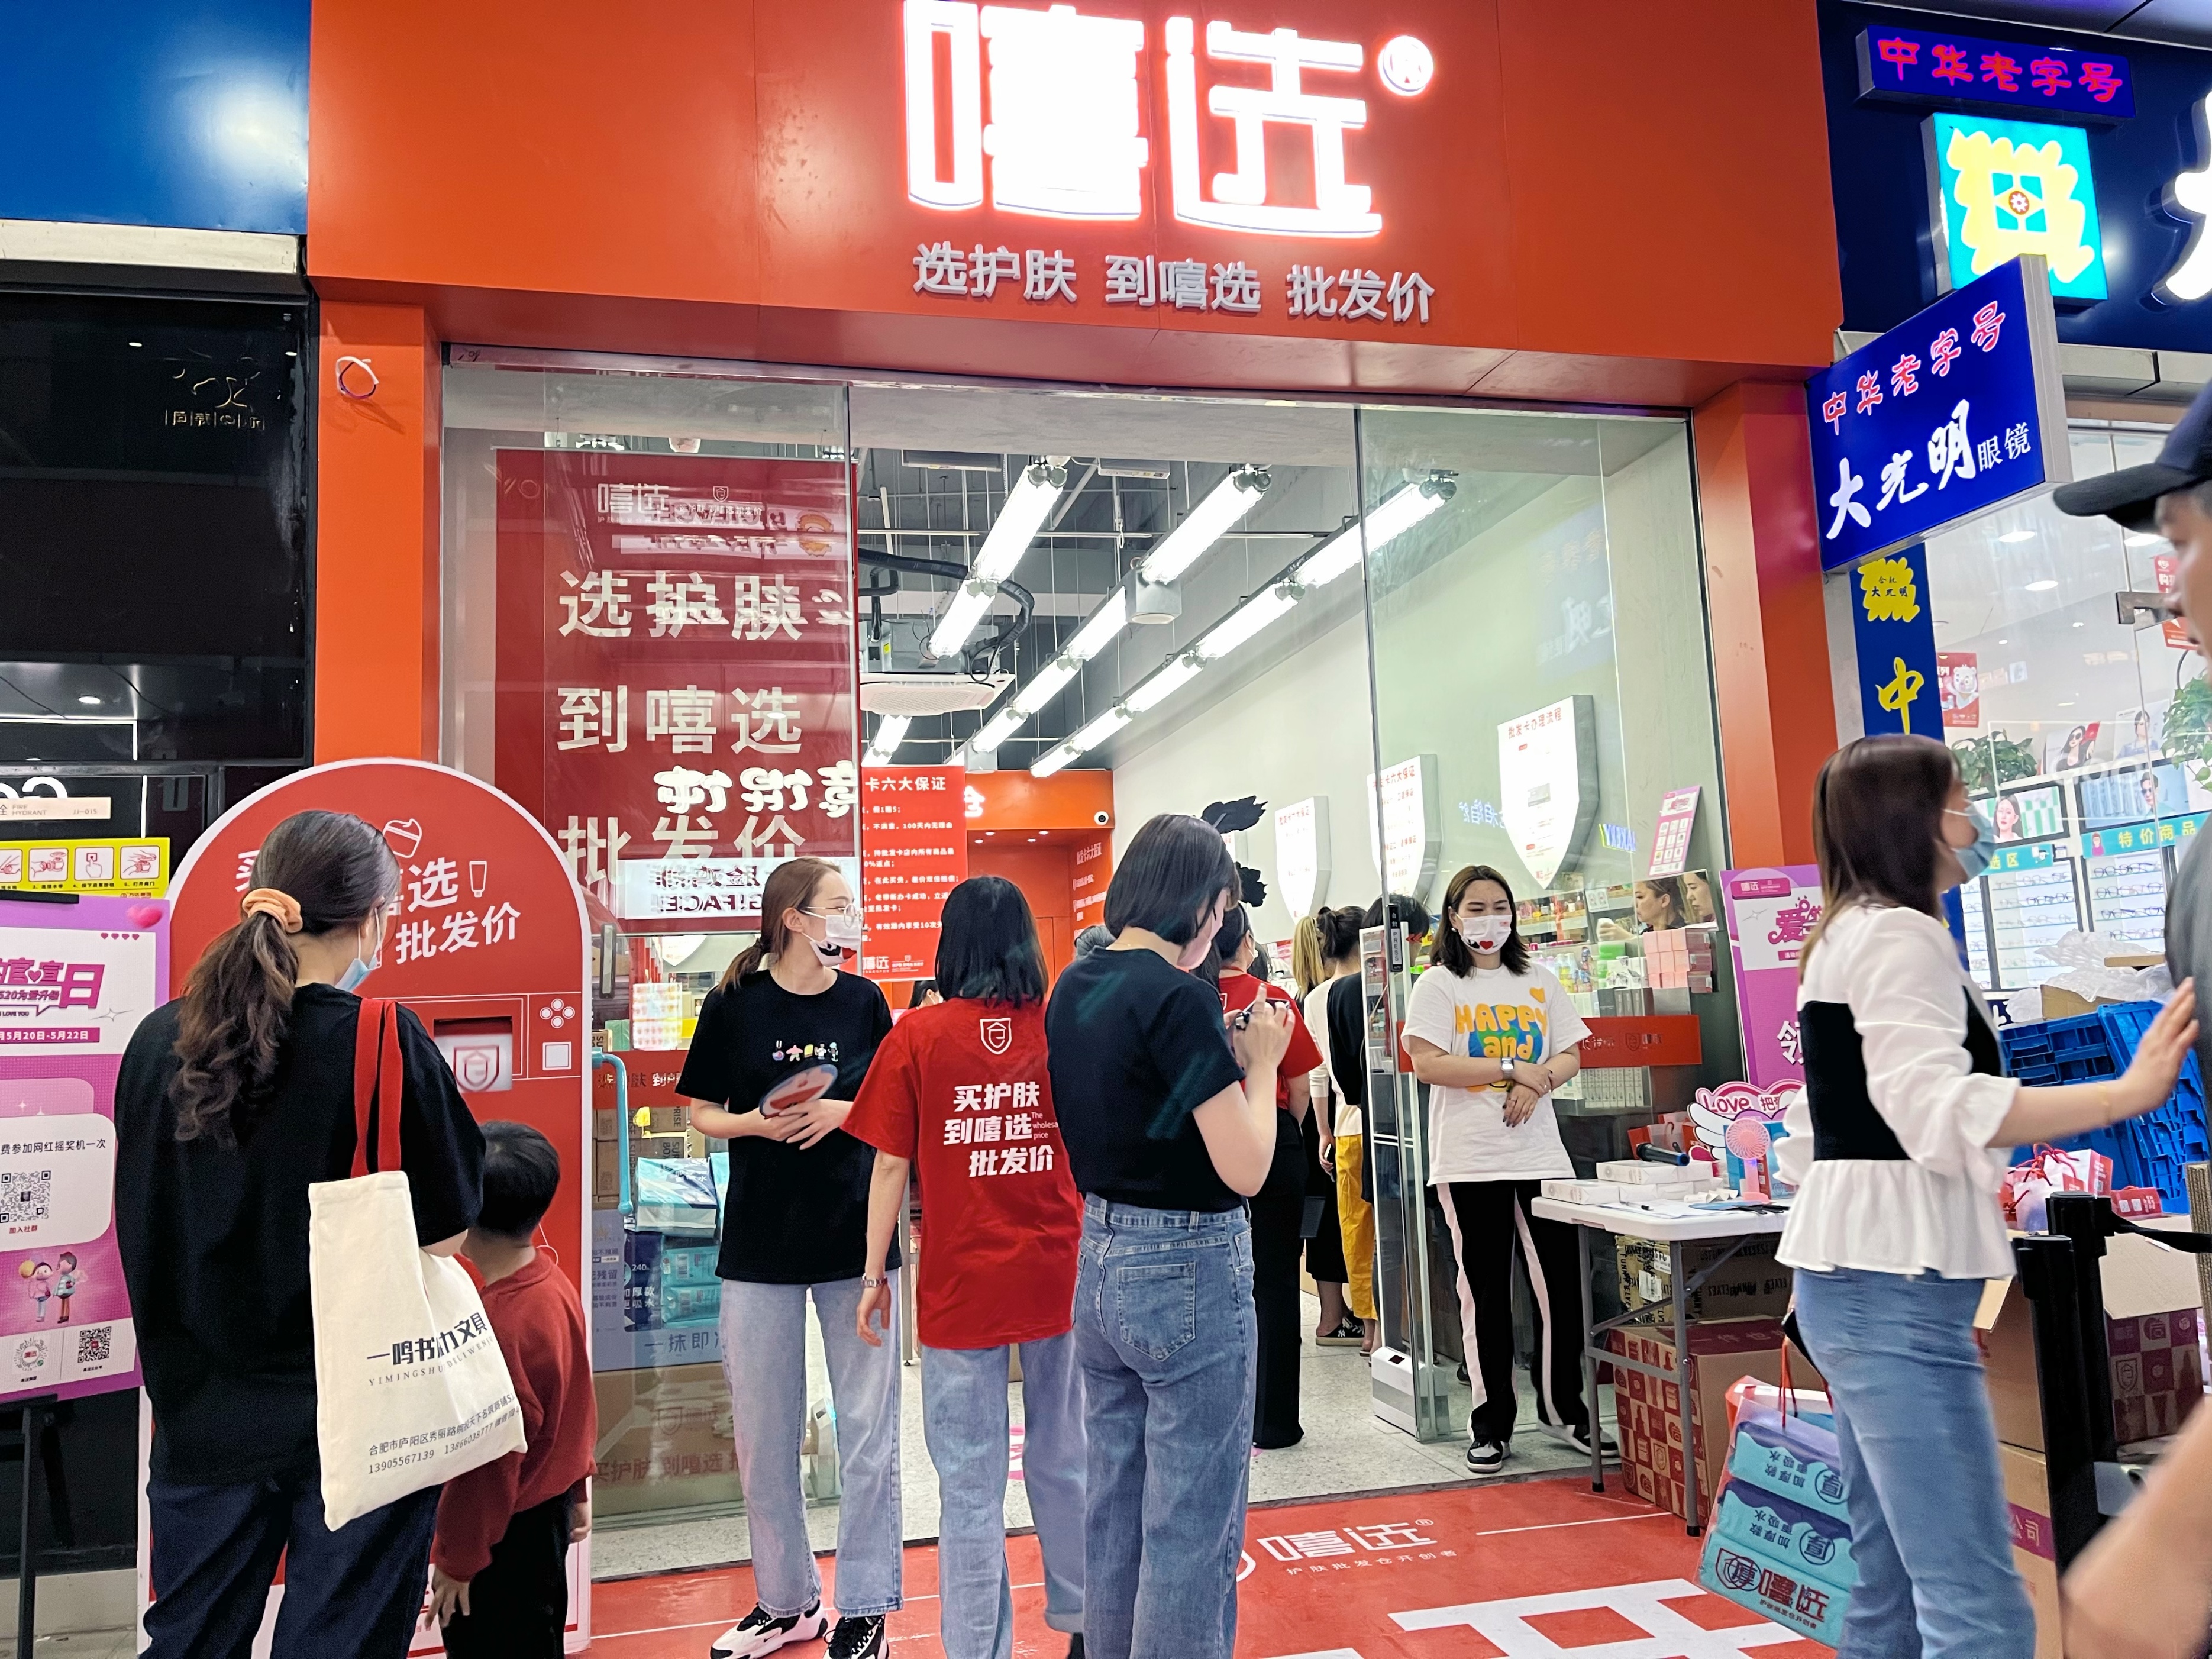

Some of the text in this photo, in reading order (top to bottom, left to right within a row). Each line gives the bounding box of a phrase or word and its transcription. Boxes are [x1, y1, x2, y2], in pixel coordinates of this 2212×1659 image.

[1878, 38, 2123, 103] 中华老字号
[913, 241, 1435, 324] 选护肤 到嘻选 批发价
[1823, 300, 2006, 435] 中华老字号
[1826, 399, 2032, 540] 大光明 眼镜
[558, 570, 803, 641] 选护肤
[557, 685, 803, 754] 到嘻选
[865, 777, 947, 792] 卡六大保证
[2118, 819, 2198, 849] 特价商品
[558, 814, 806, 886] 批发价
[396, 902, 521, 964] 批发价
[1455, 1003, 1548, 1037] HAPPY
[1483, 1035, 1534, 1060] and
[953, 1081, 1041, 1112] 买护肤
[1703, 1094, 1752, 1113] Love
[943, 1114, 1032, 1145] 到嘻选
[1033, 1132, 1049, 1141] price
[968, 1144, 1055, 1178] 批发价
[9, 1225, 38, 1235] 加入社群
[631, 1263, 647, 1271] 240
[368, 1450, 435, 1475] 13905567139
[1286, 1549, 1457, 1576] 护肤批发仓开创者
